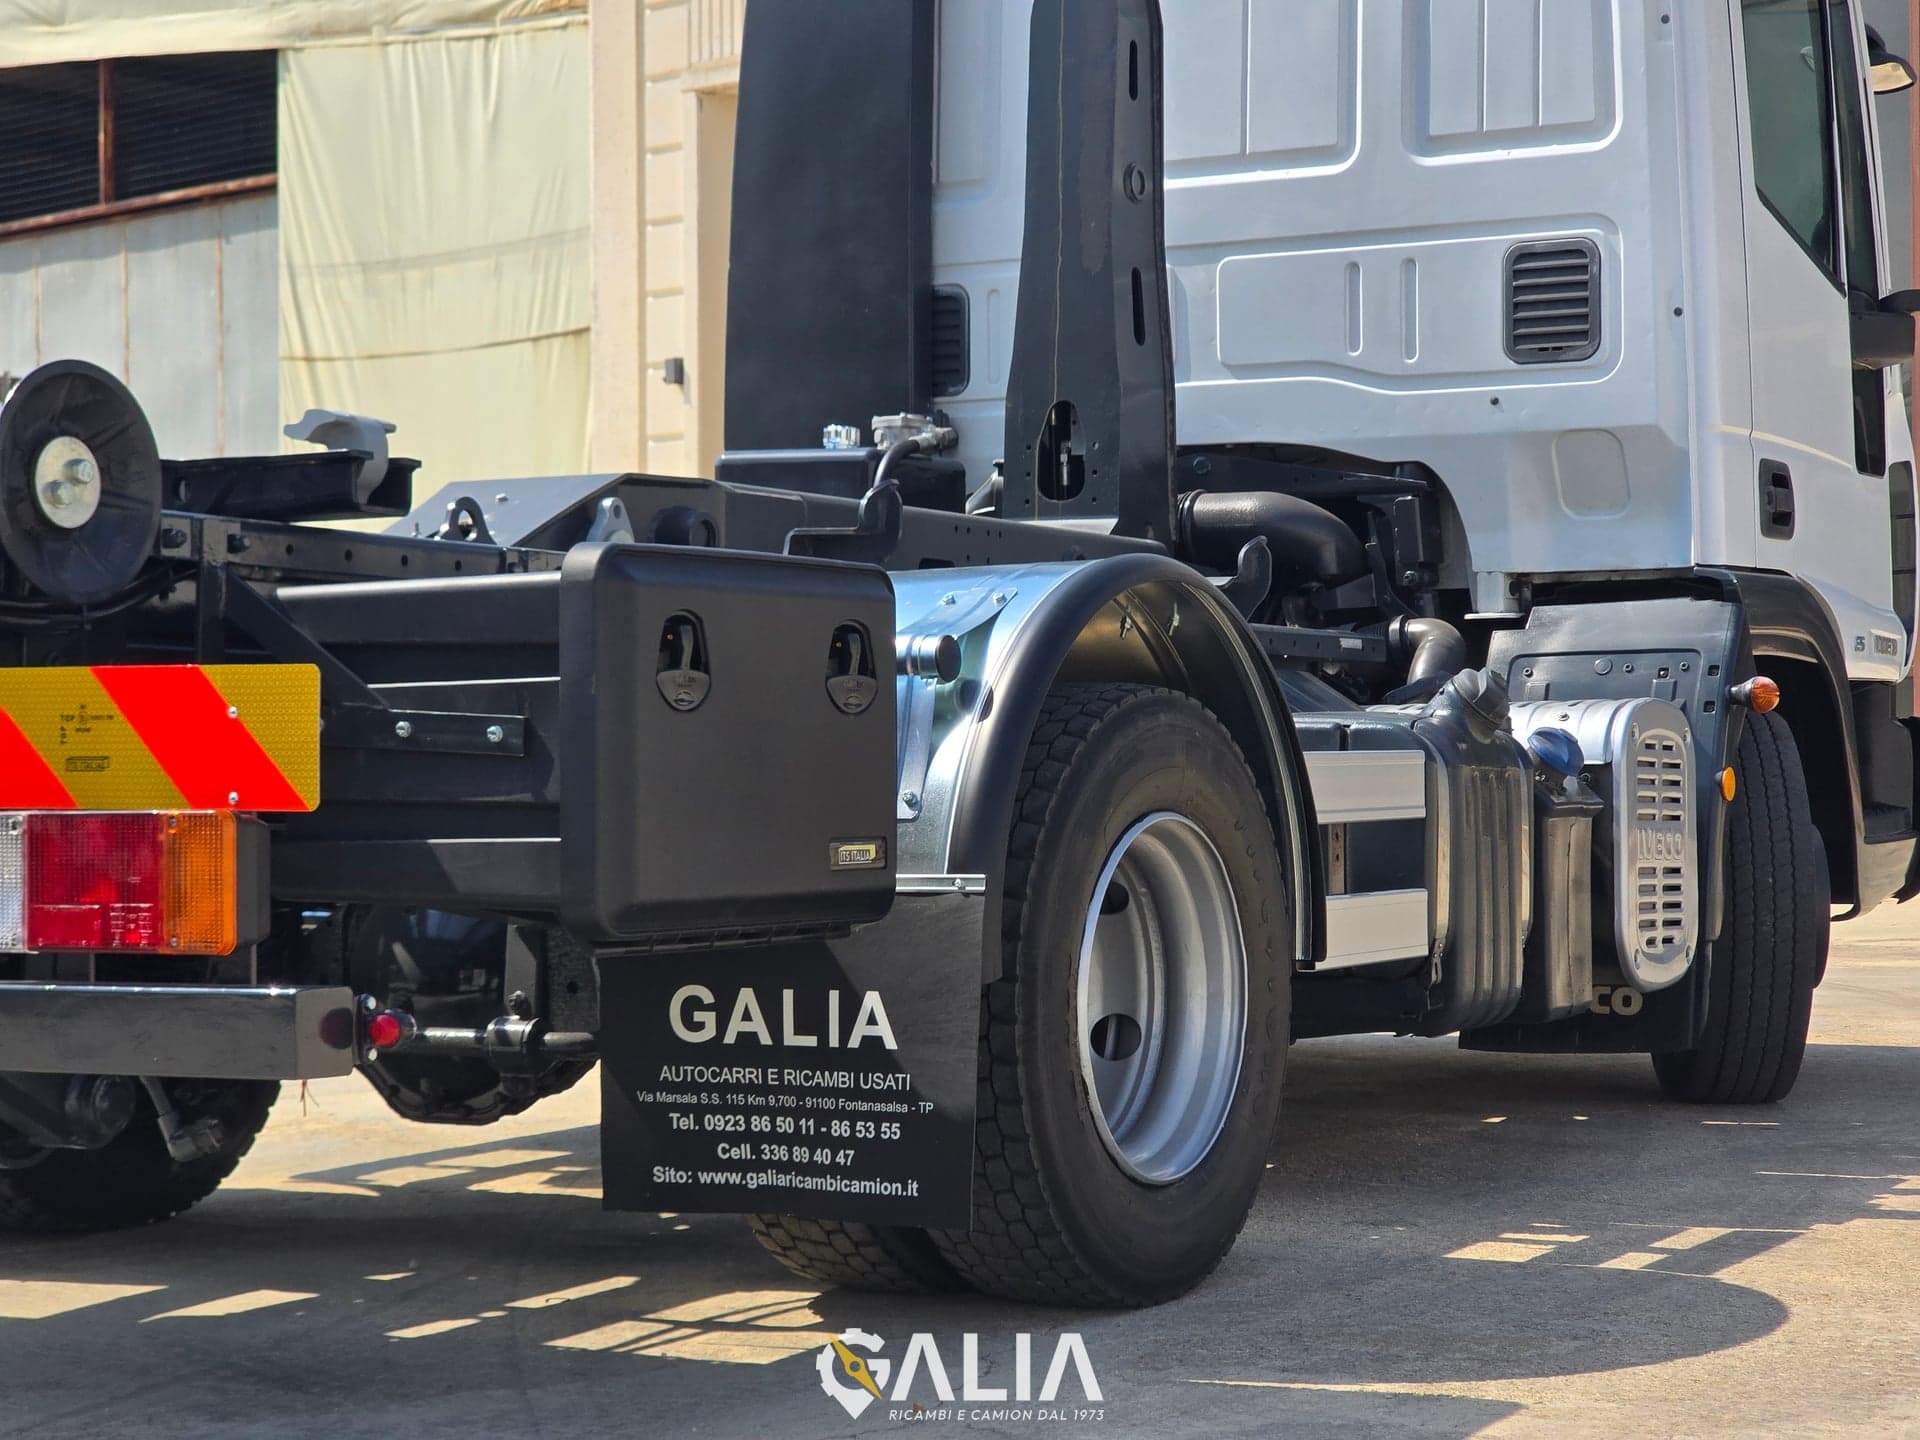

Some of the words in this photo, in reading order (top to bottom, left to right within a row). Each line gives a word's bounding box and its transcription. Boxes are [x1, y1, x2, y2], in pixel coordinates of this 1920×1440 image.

[851, 850, 871, 861] ITALIA
[1637, 828, 1684, 861] IVECO
[668, 984, 899, 1051] GALIA
[659, 1065, 763, 1085] AUTOCARRI
[768, 1069, 780, 1085] E
[784, 1069, 855, 1089] RICAMBI
[859, 1072, 911, 1091] USATI
[636, 1090, 654, 1103] Via
[656, 1092, 698, 1104] Marsala
[701, 1093, 723, 1105] S.S.
[726, 1094, 746, 1106] 115
[748, 1094, 766, 1106] Km
[768, 1095, 797, 1108] 9,700
[805, 1097, 836, 1110] 91100
[838, 1098, 908, 1113] Fontanasalsa
[918, 1101, 934, 1114] TP
[669, 1112, 700, 1131] Tel.
[704, 1114, 746, 1132] 0923
[750, 1116, 772, 1133] 86
[775, 1117, 795, 1134] 50
[799, 1118, 815, 1135] 11
[831, 1120, 851, 1138] 86
[855, 1121, 876, 1139] 53
[880, 1123, 901, 1140] 55
[717, 1143, 757, 1160] Cell.
[760, 1144, 789, 1162] 336
[793, 1146, 810, 1164] 89
[813, 1148, 832, 1165] 40
[836, 1149, 855, 1167] 47
[653, 1166, 693, 1184] Sito:
[697, 1170, 919, 1197] www.galiaricambicamion.it
